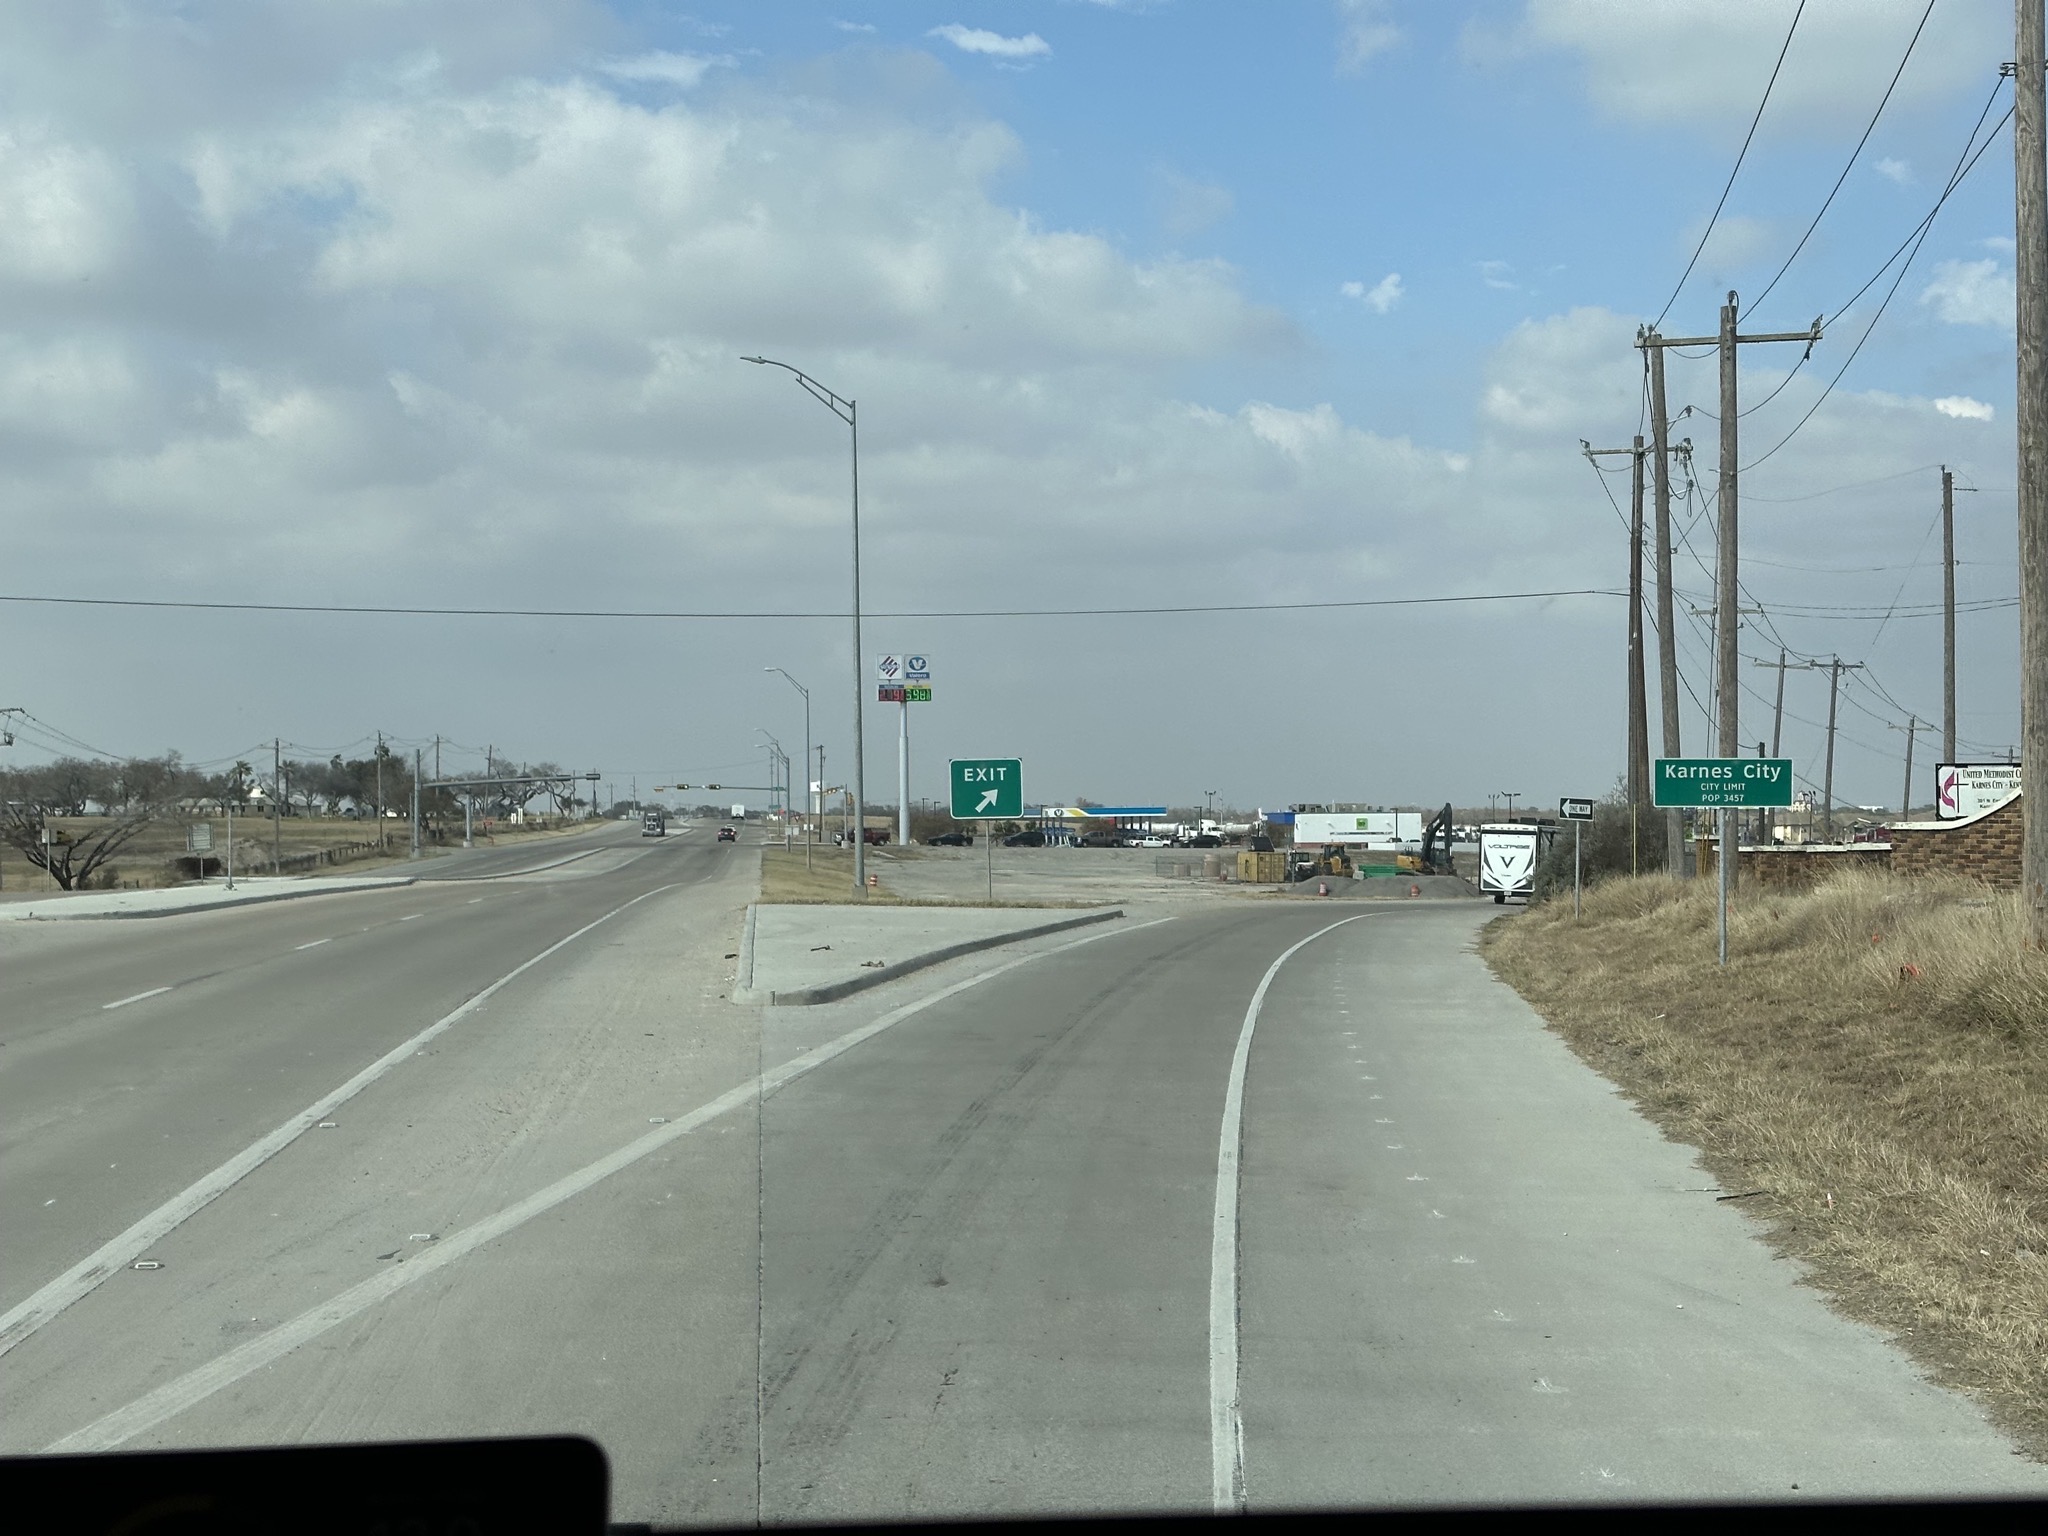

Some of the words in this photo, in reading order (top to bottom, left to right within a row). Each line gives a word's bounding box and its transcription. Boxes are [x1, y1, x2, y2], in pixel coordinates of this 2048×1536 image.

[964, 768, 1007, 782] EXIT
[1665, 764, 1733, 779] Karnes
[1743, 763, 1781, 782] City
[1962, 769, 1982, 779] UNITED
[1983, 769, 2014, 779] METHODIST
[1700, 783, 1719, 791] CITY
[1723, 783, 1745, 791] LIMIT
[1972, 781, 1991, 789] KARNES
[1992, 780, 2003, 789] CITY
[1702, 794, 1720, 802] POP
[1723, 794, 1745, 802] 3457
[1569, 805, 1578, 813] ONE
[1579, 805, 1589, 813] WAY
